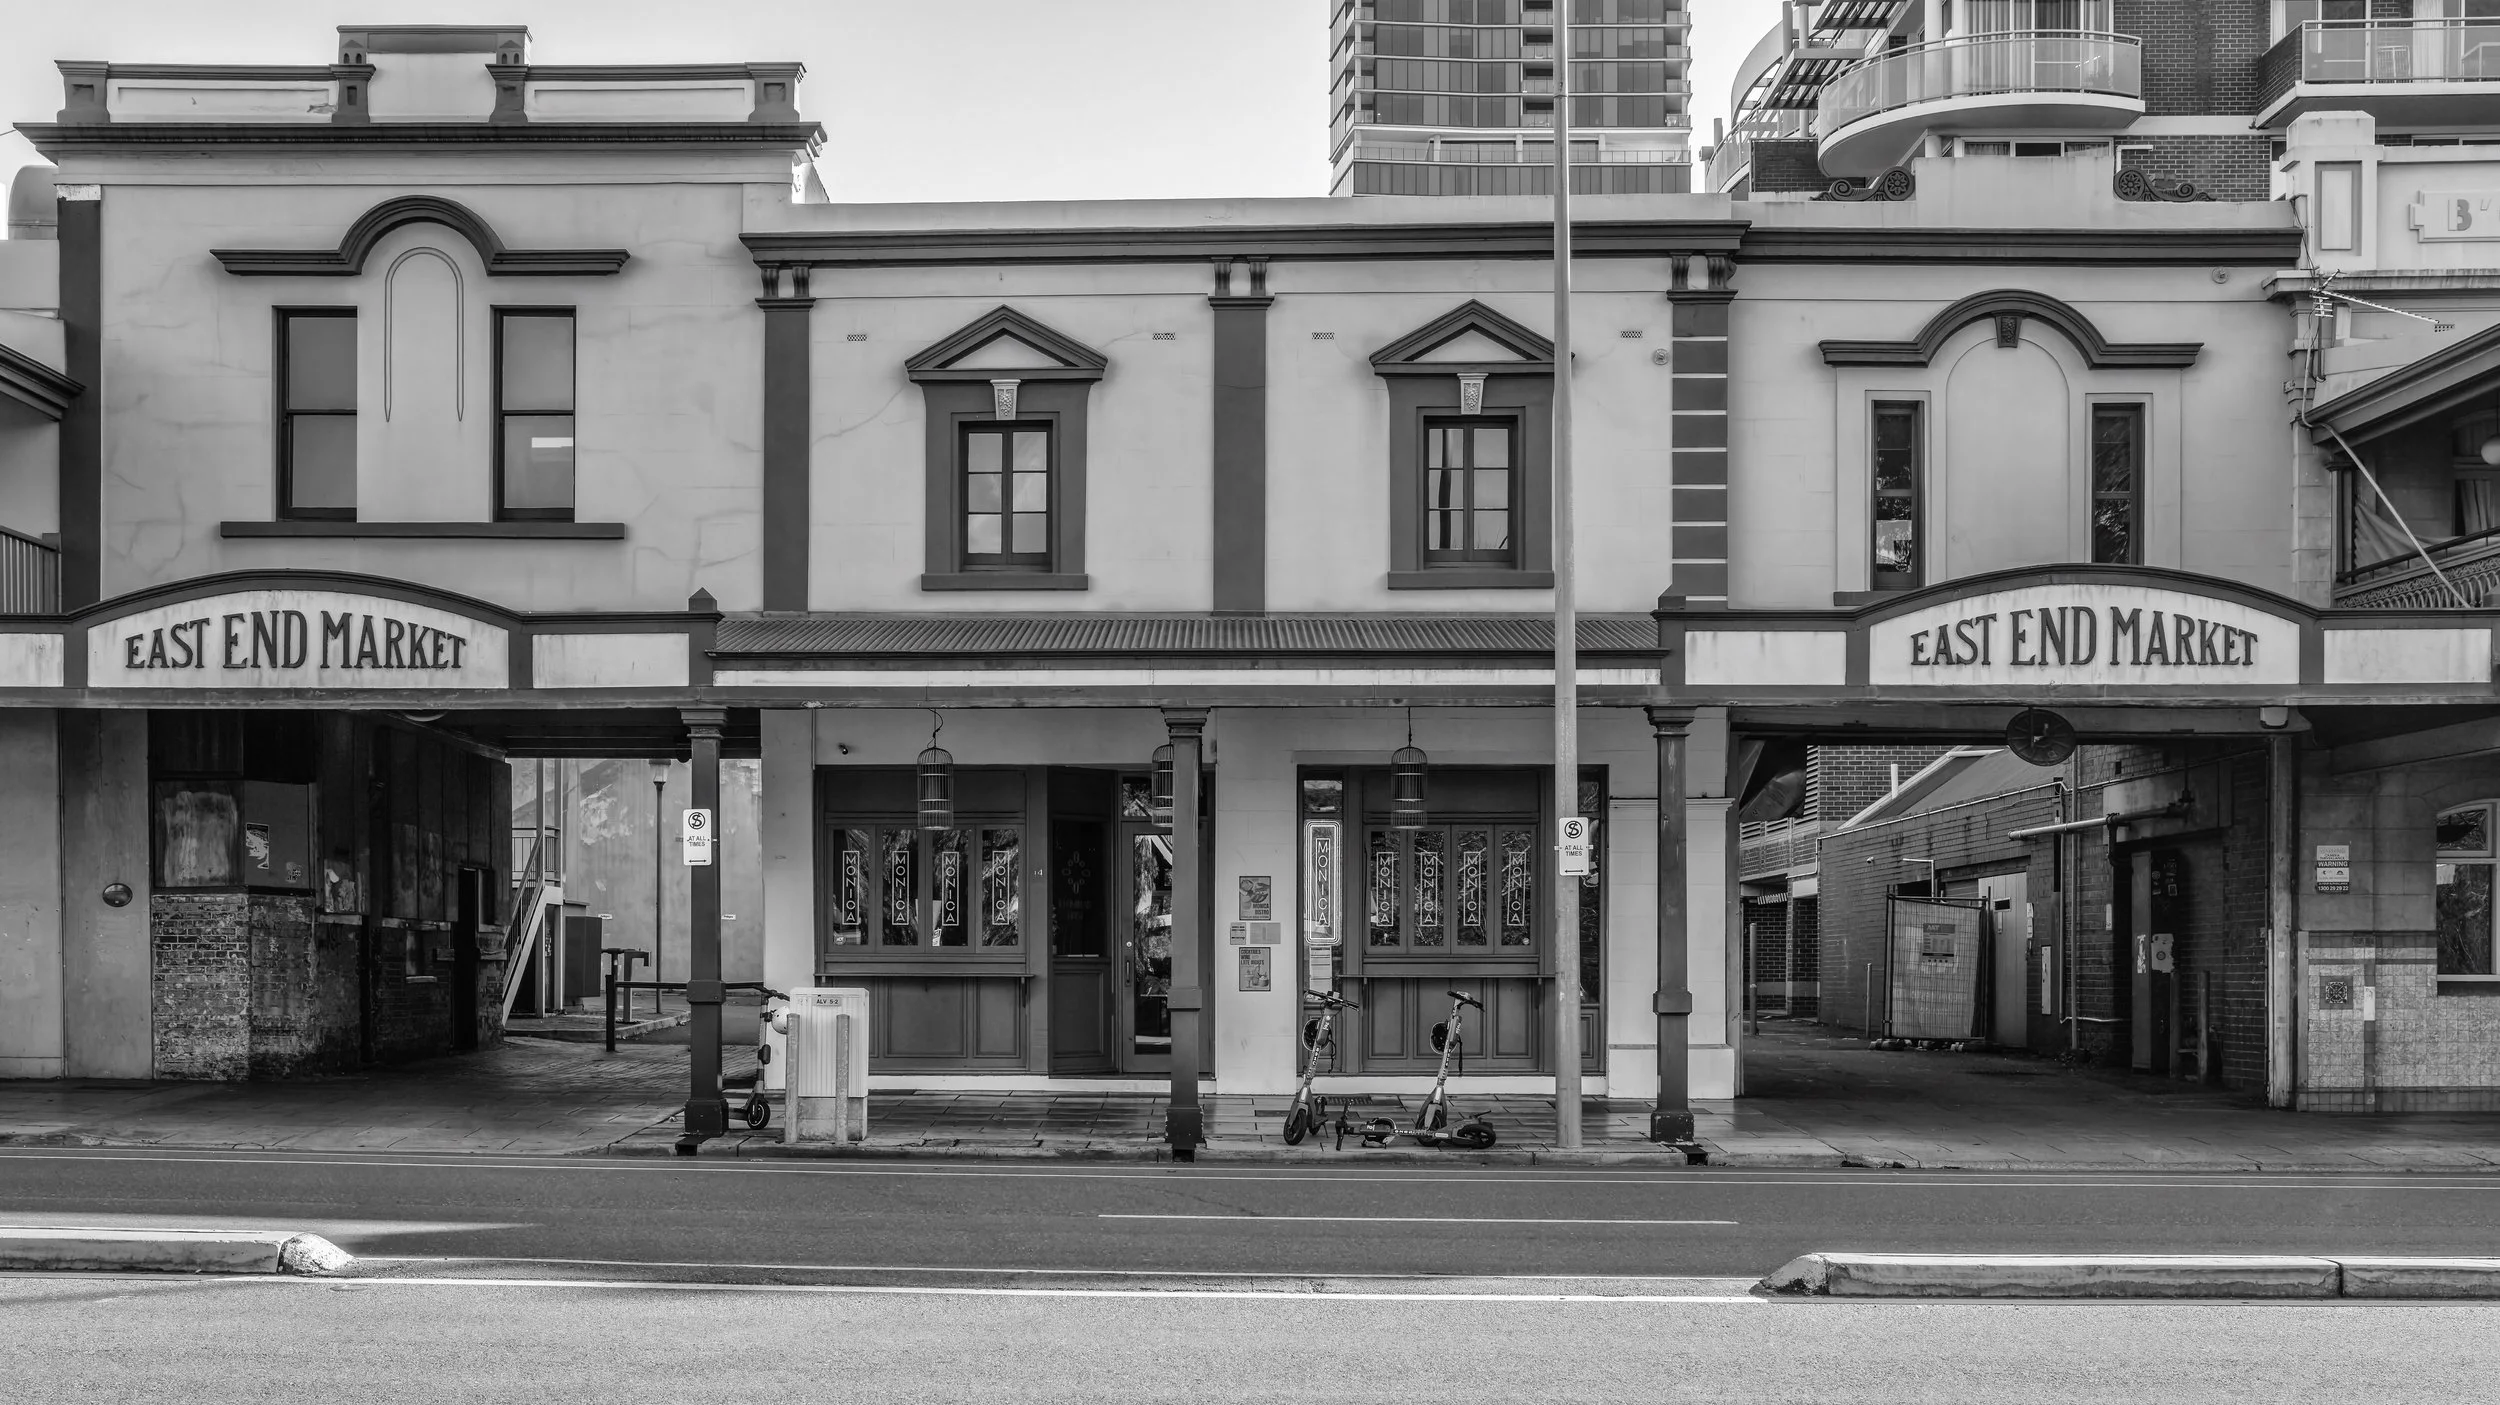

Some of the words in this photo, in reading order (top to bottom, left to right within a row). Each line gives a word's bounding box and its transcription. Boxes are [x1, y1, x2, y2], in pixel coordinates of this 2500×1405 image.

[125, 616, 211, 669] EAST
[221, 609, 308, 669] END
[319, 610, 467, 669] MARKET
[1910, 612, 1998, 666] EAST
[2009, 605, 2098, 666] END
[2109, 606, 2259, 667] MARKET
[894, 855, 906, 922] MONICA
[944, 855, 957, 923] MONICA
[994, 855, 1007, 922] MONICA
[1317, 840, 1329, 925] MONICA
[1379, 856, 1391, 923] MONICA
[1423, 856, 1435, 923] MONICA
[1466, 856, 1478, 923] MONICA
[1510, 856, 1524, 923] MONICA
